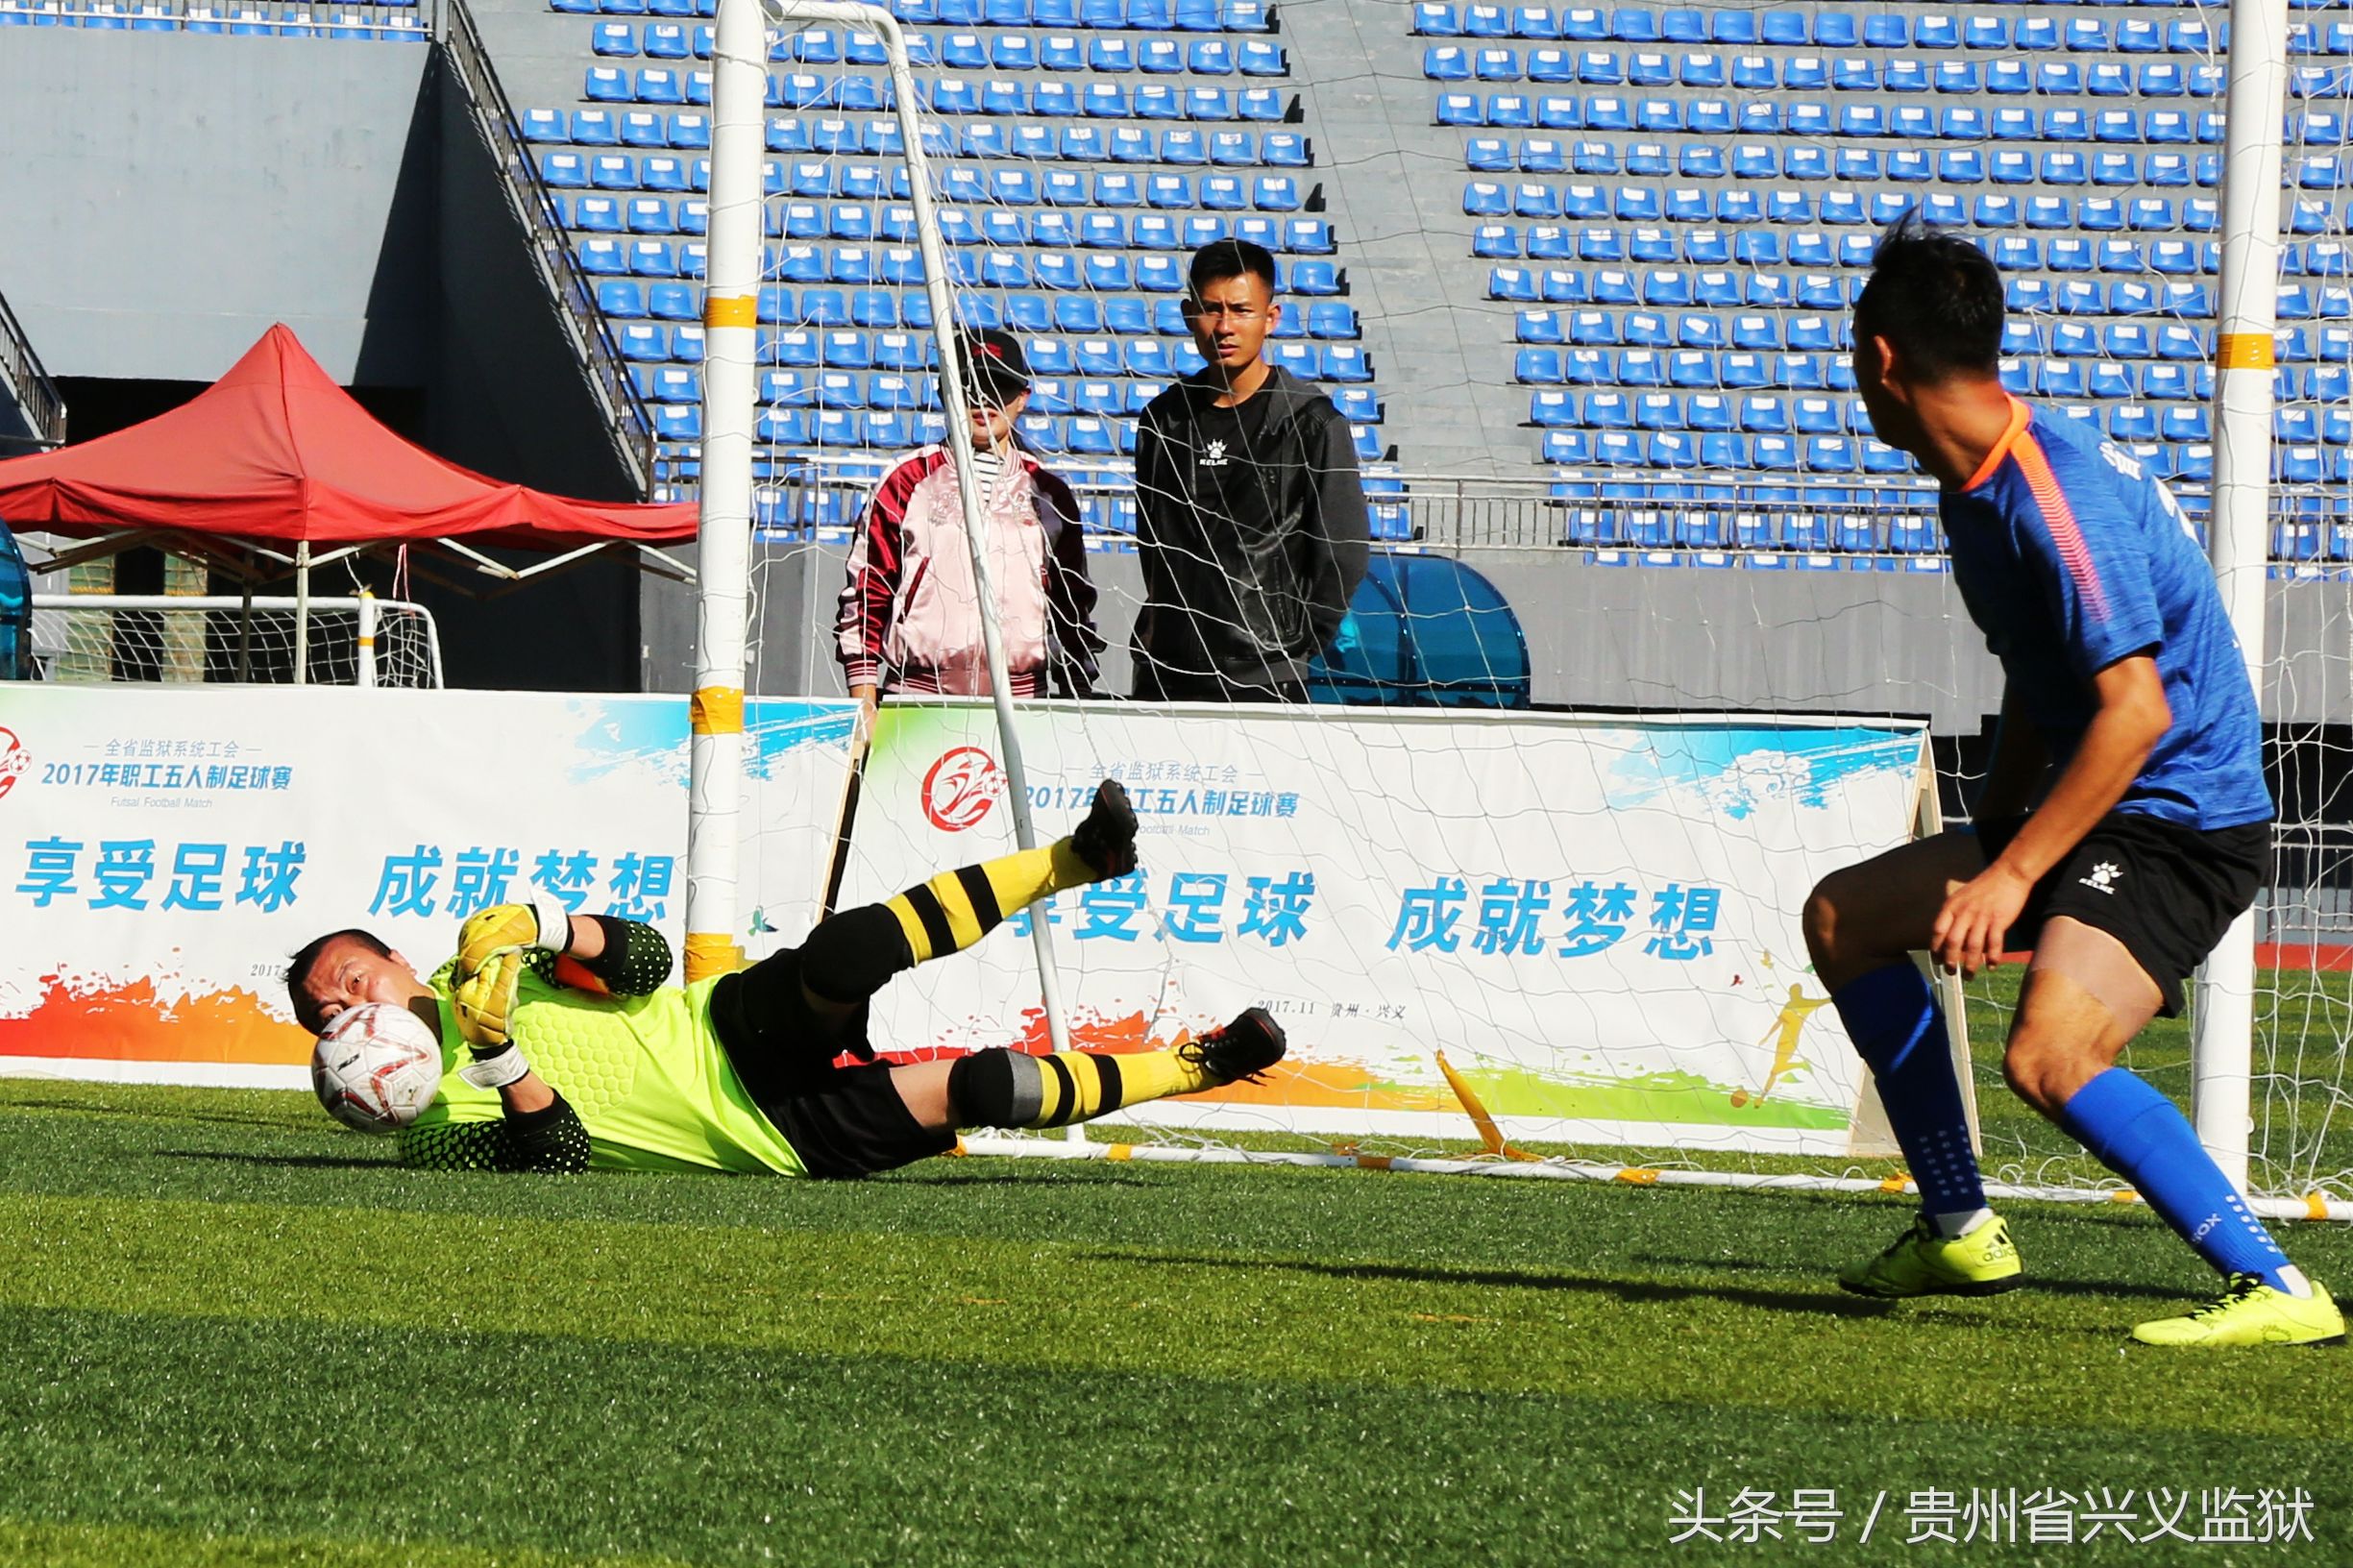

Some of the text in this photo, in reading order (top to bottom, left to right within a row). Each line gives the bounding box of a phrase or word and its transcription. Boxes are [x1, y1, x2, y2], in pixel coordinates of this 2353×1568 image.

[104, 739, 240, 759] 全省监狱系统工会
[41, 763, 293, 791] 2017年职工五人制足球赛
[1090, 761, 1238, 784] 全省监狱系统工会
[110, 796, 212, 809] Futsal Football Match
[1026, 786, 1300, 819] 2017年工五人制足球赛
[1138, 824, 1211, 837] ootball Match
[15, 836, 674, 923] 享受足球 成就梦想
[1385, 876, 1722, 962] 成就梦想
